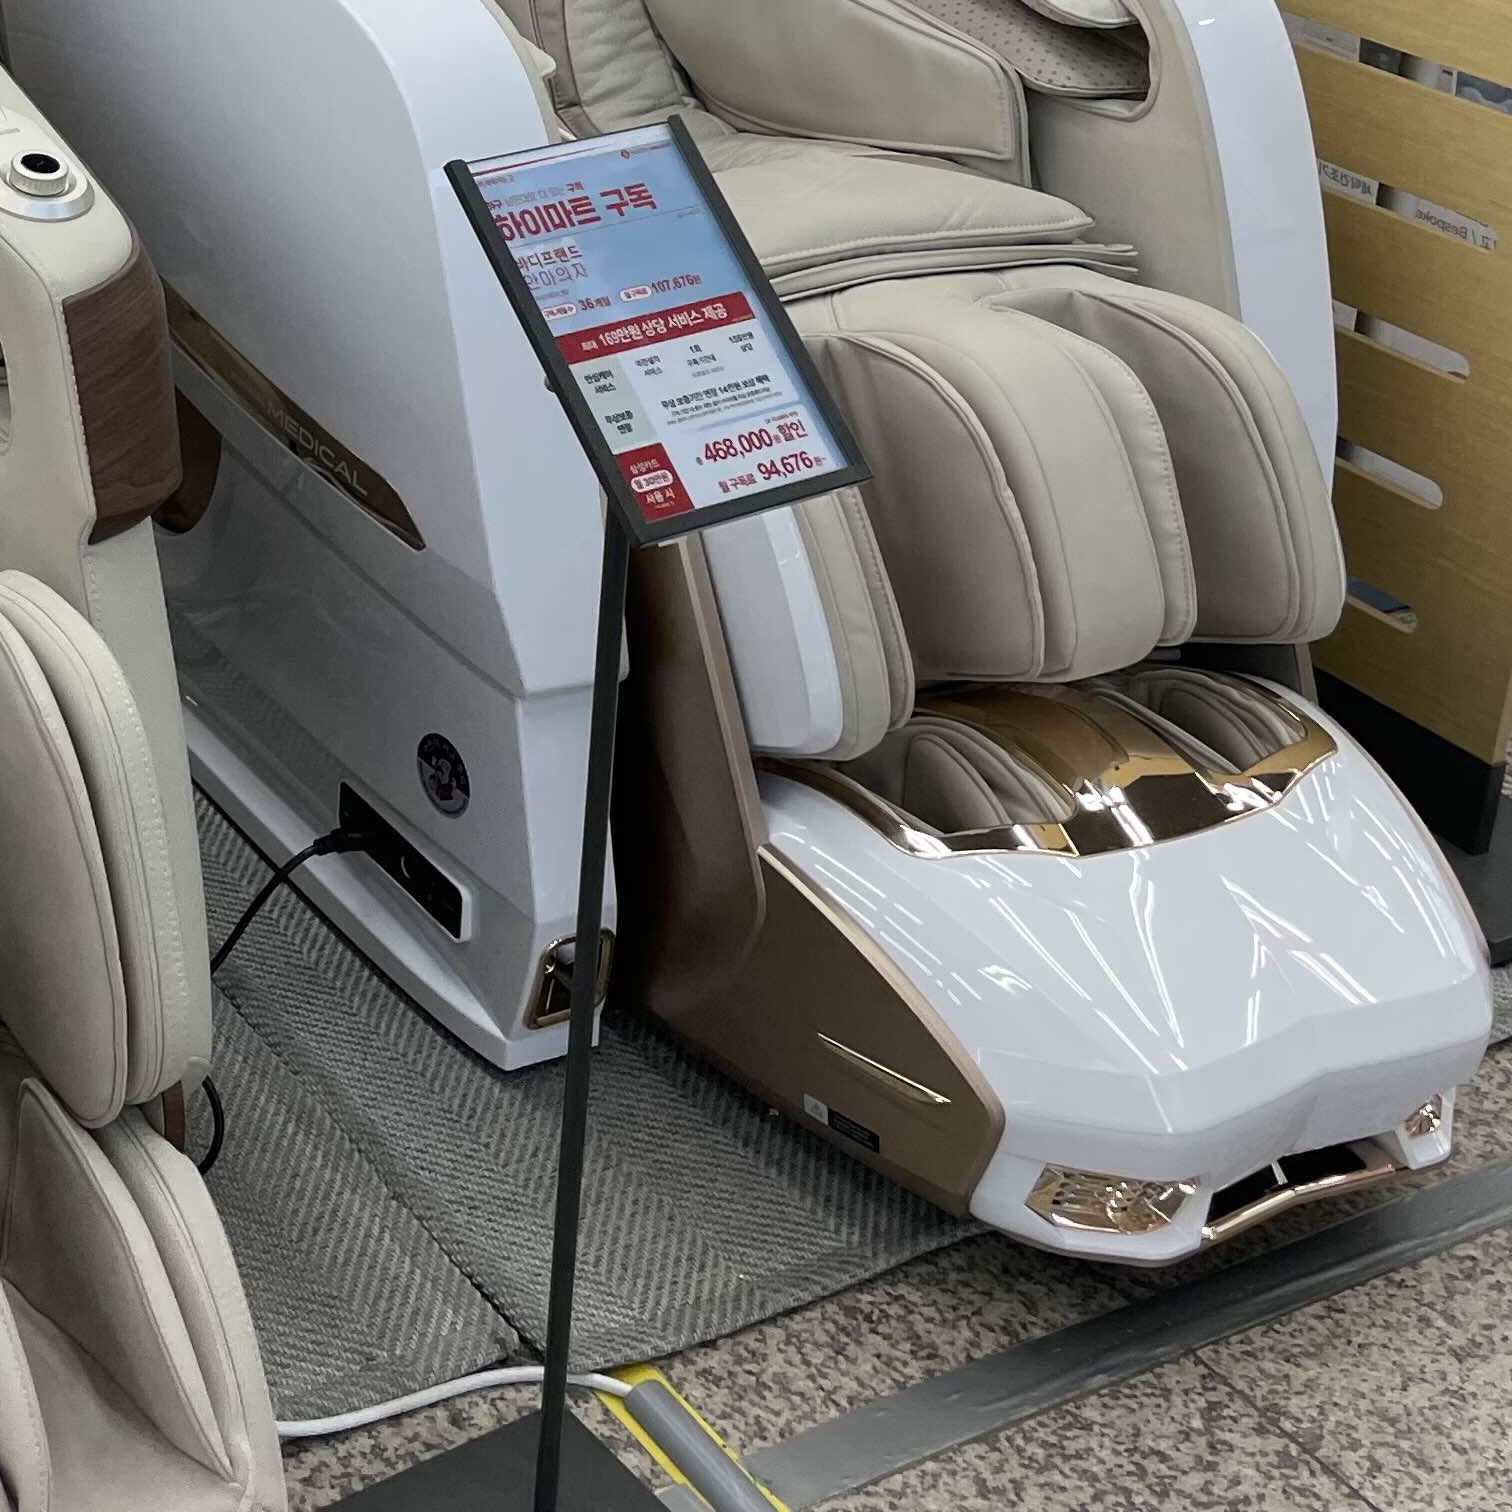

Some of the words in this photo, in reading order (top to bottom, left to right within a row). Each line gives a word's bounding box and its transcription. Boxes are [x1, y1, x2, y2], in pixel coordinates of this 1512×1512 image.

[494, 195, 601, 241] 하이마트
[600, 183, 657, 217] 구독
[516, 245, 584, 271] 바디프랜드
[523, 262, 588, 289] 안마의자
[598, 325, 642, 348] 169만원
[642, 318, 667, 337] 상당
[668, 309, 703, 331] 서비스
[703, 302, 728, 322] 제공
[267, 400, 369, 497] MEDICAL
[776, 420, 809, 443] 할인
